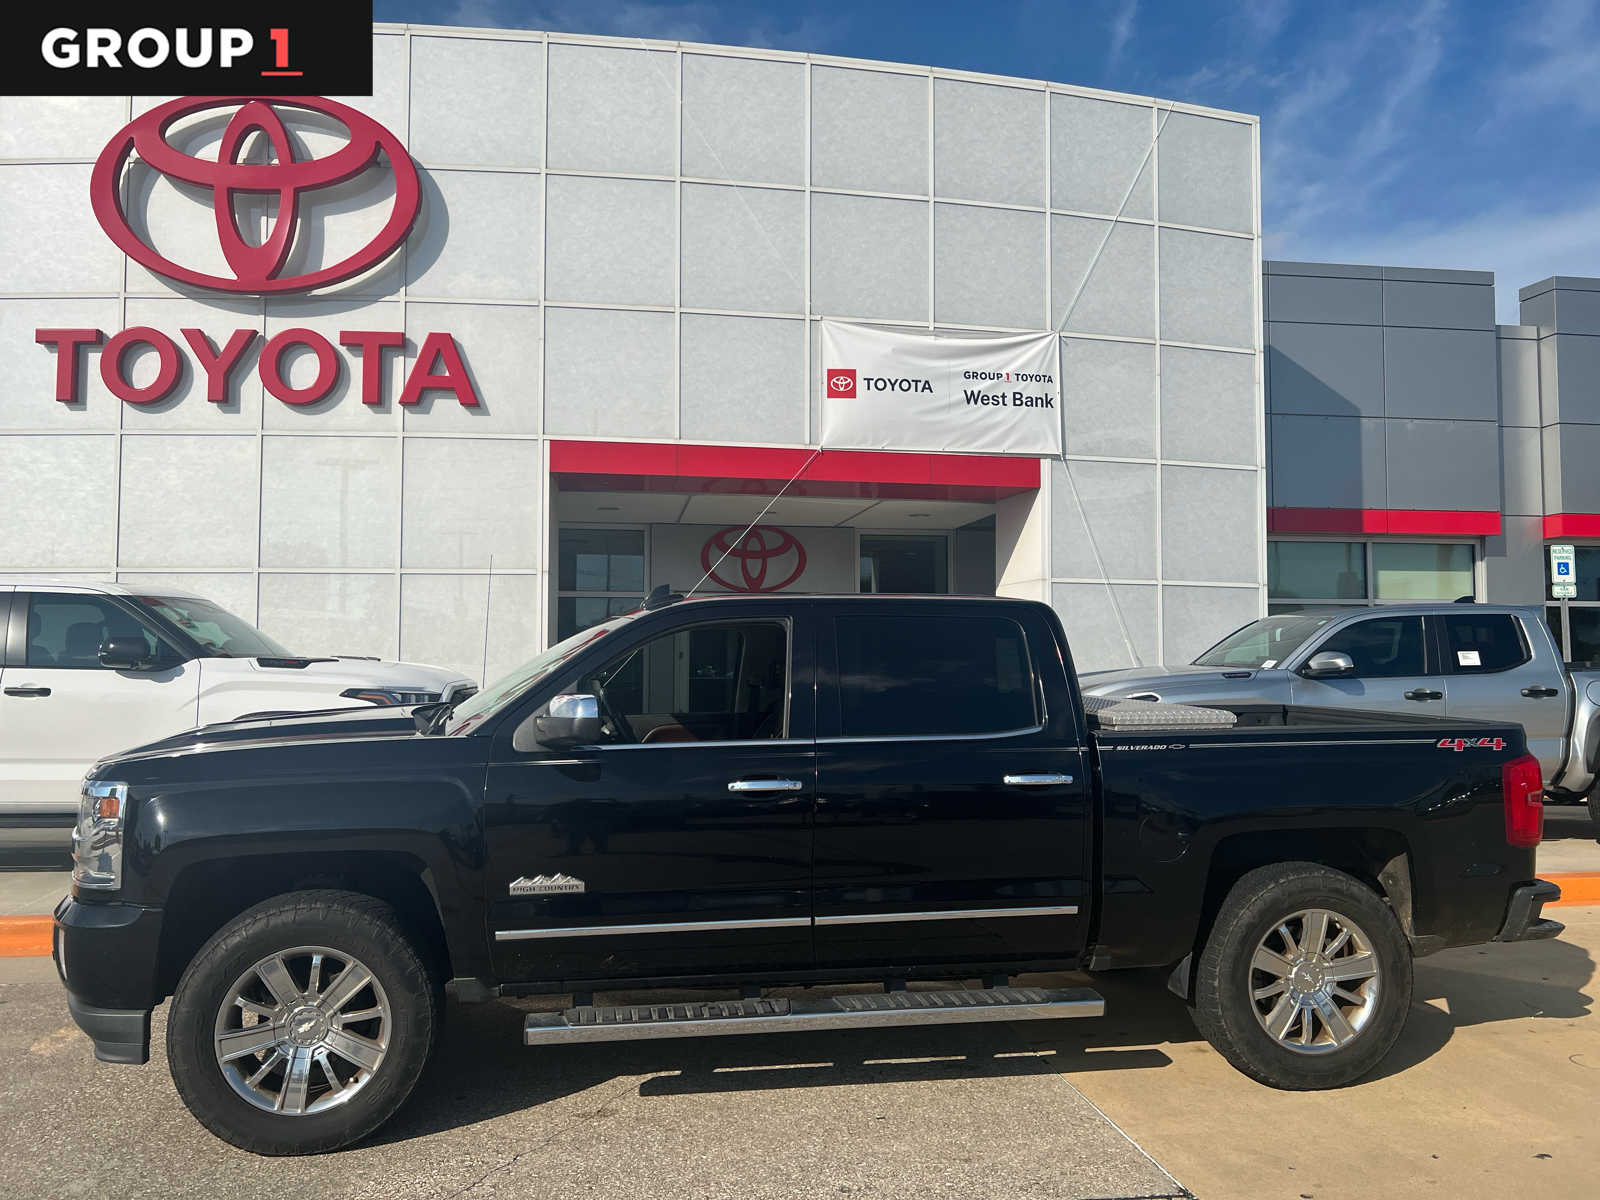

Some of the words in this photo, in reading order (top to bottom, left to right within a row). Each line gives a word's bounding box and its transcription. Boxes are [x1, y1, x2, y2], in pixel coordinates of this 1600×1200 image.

[35, 326, 481, 406] TOYOTA
[863, 377, 933, 393] TOYOTA
[963, 371, 1003, 380] GROUP
[1015, 373, 1053, 383] TOYOTA
[963, 389, 1007, 406] West
[1012, 391, 1054, 408] Bank
